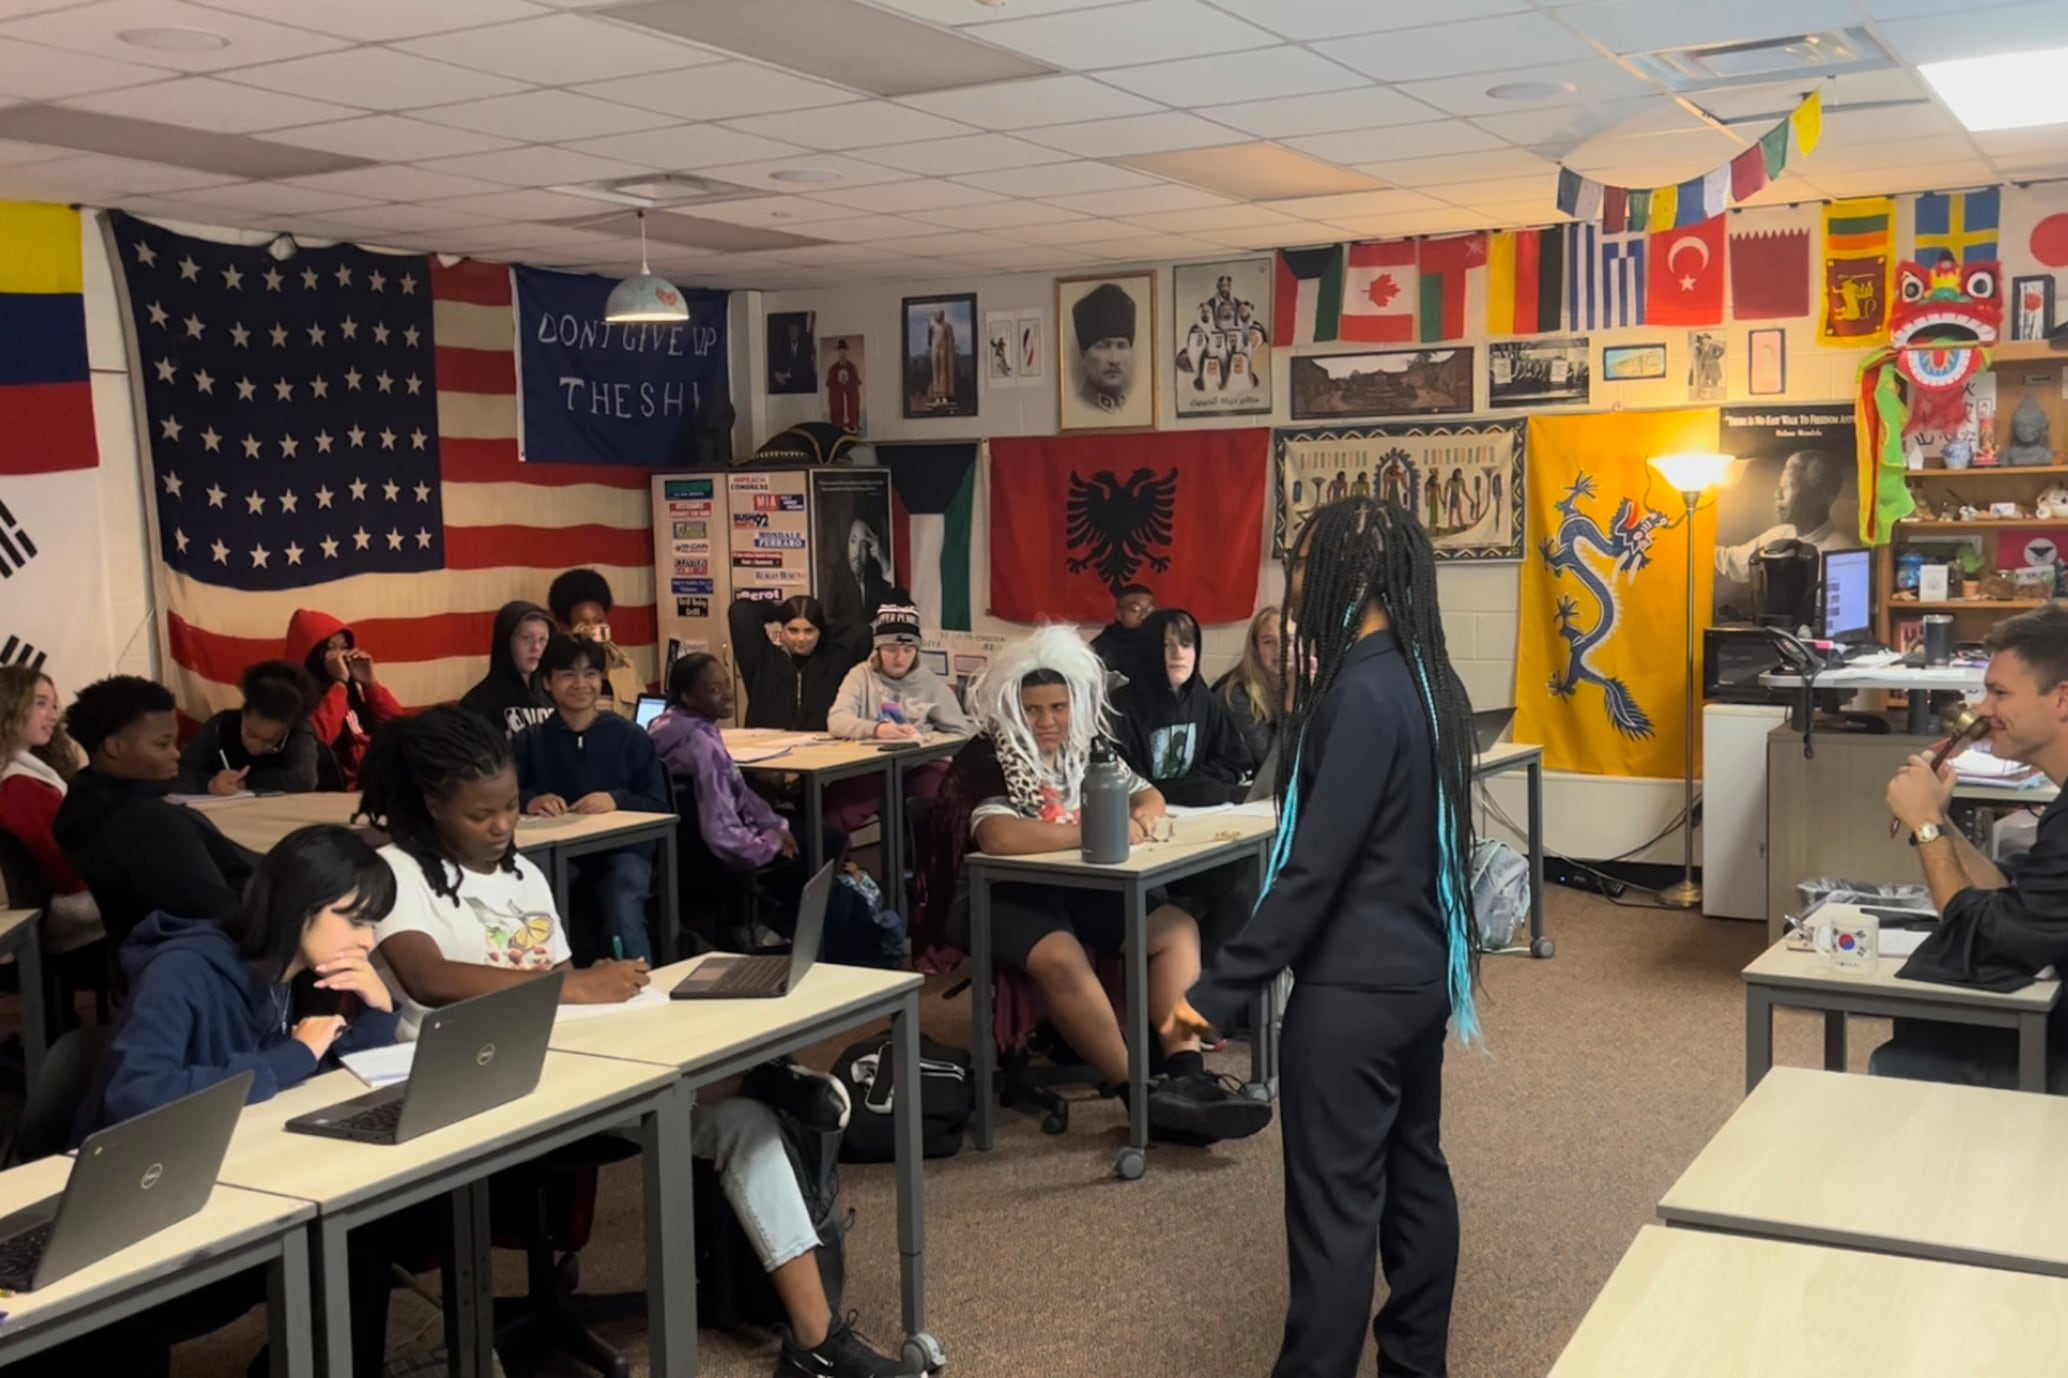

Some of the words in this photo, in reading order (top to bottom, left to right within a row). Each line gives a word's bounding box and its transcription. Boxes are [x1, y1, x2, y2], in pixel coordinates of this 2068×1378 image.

[537, 312, 616, 350] DONT
[622, 322, 684, 356] GIVE
[692, 326, 718, 356] UP
[559, 376, 632, 418] THE
[640, 381, 701, 418] SHI
